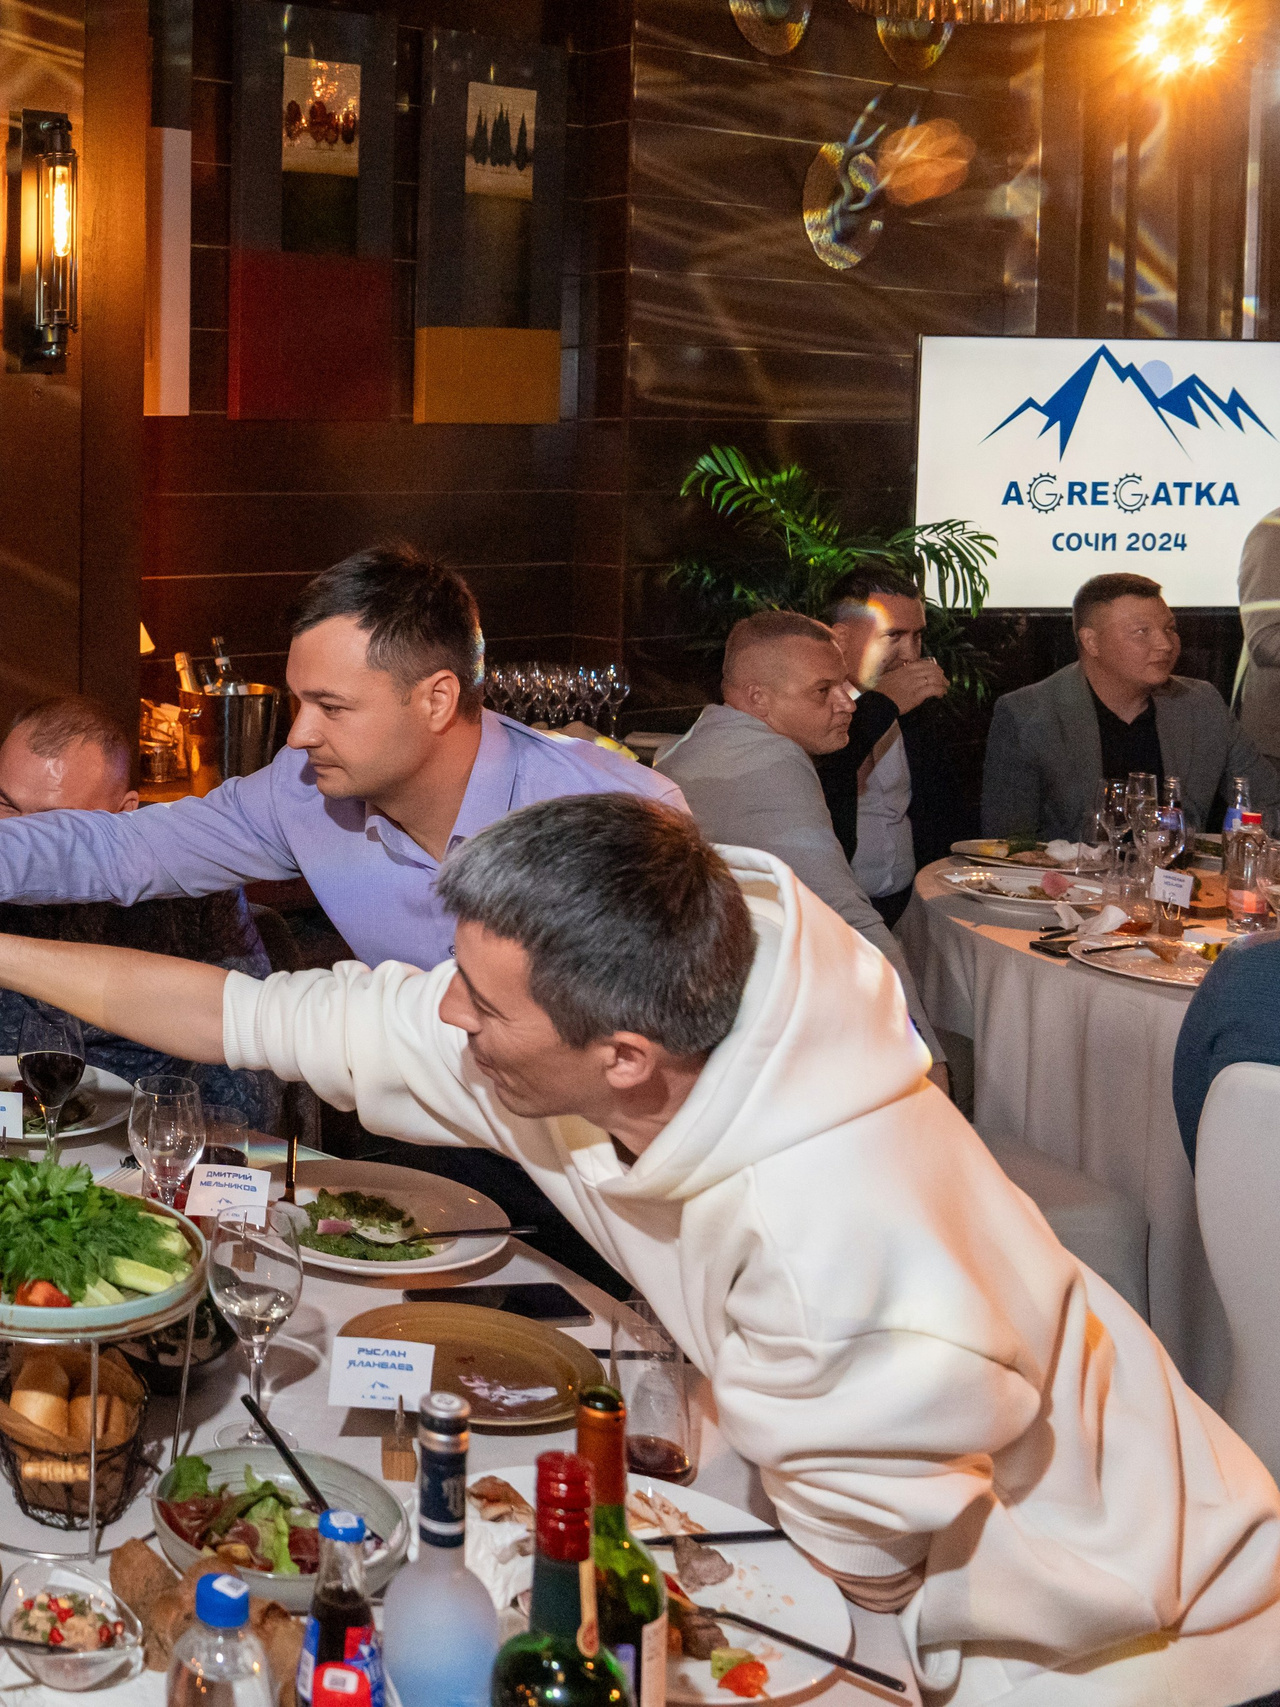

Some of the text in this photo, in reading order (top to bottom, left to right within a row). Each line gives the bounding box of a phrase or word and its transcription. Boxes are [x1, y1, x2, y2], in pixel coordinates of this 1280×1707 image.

[1001, 472, 1240, 514] AGREGATKA
[1052, 532, 1188, 551] СОЧИ 2024
[206, 1171, 253, 1181] ДМИТРИЙ
[200, 1180, 257, 1192] МЕЛЬНИКОВ
[357, 1347, 407, 1358] РУСЛАН
